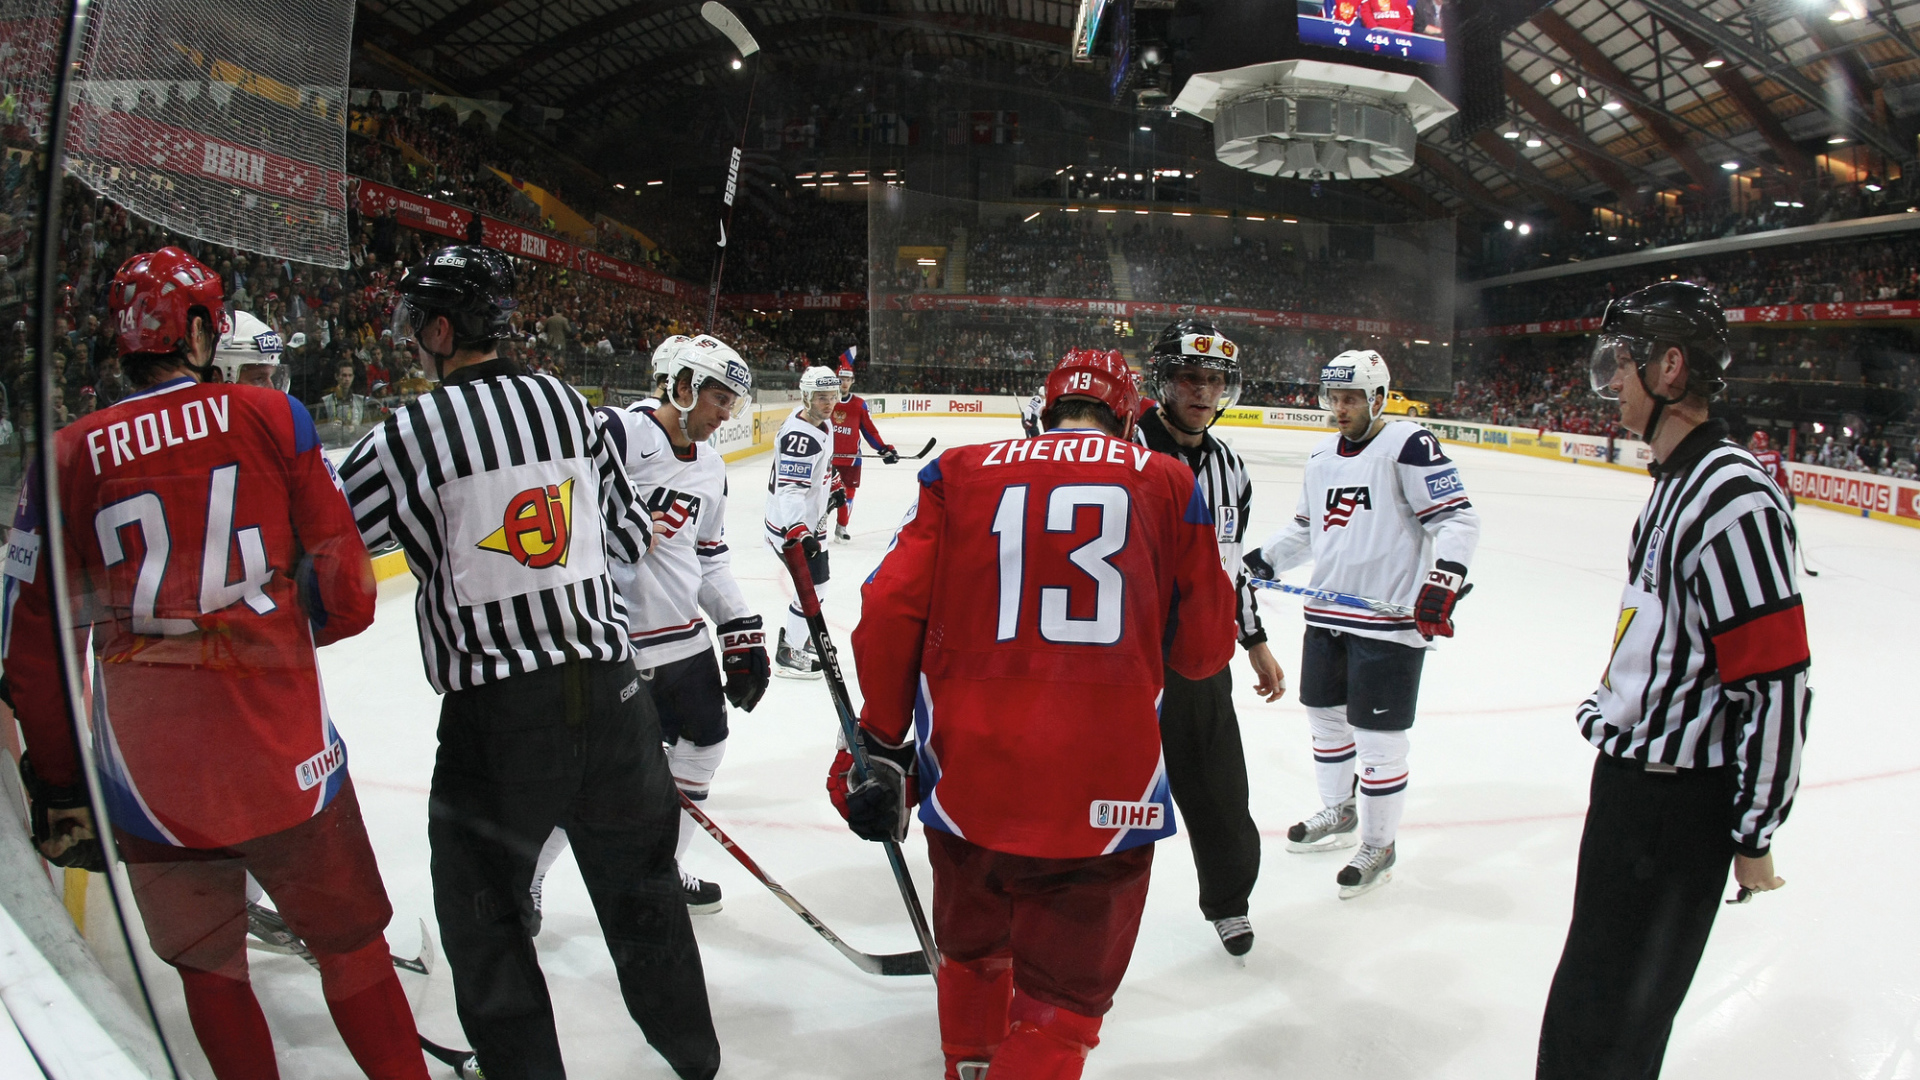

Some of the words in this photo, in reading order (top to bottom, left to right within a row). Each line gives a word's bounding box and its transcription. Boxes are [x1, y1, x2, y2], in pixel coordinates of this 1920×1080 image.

[1334, 28, 1351, 36] RUS
[1338, 37, 1347, 46] 4
[1365, 34, 1390, 46] 4:54
[1395, 38, 1412, 47] USA
[1401, 47, 1408, 56] 1
[203, 140, 266, 185] BERN
[723, 146, 742, 207] BAUER
[399, 199, 423, 214] WELCOME
[423, 206, 431, 216] TO
[425, 215, 448, 229] COUNTRY
[521, 232, 548, 258] BERN
[436, 256, 467, 268] CCM
[803, 295, 842, 308] BERN
[1087, 301, 1127, 315] BERN
[118, 308, 136, 333] 24
[1356, 319, 1391, 333] BERN
[1070, 371, 1092, 390] 13
[908, 399, 931, 411] IIHF
[949, 399, 983, 413] Persil
[1238, 412, 1260, 420] БАНК
[1286, 412, 1325, 423] TISSOT
[86, 394, 229, 476] FROLOV
[786, 434, 809, 455] 26
[982, 437, 1152, 473] ZHERDEV
[1419, 435, 1441, 462] 2
[1793, 472, 1890, 511] BAUHAUS
[647, 485, 702, 539] USA
[1323, 486, 1372, 532] USA
[94, 461, 278, 636] 24
[990, 482, 1131, 646] 13
[822, 635, 842, 680] CCM
[311, 743, 340, 780] IIHF
[1112, 804, 1159, 827] IIHF
